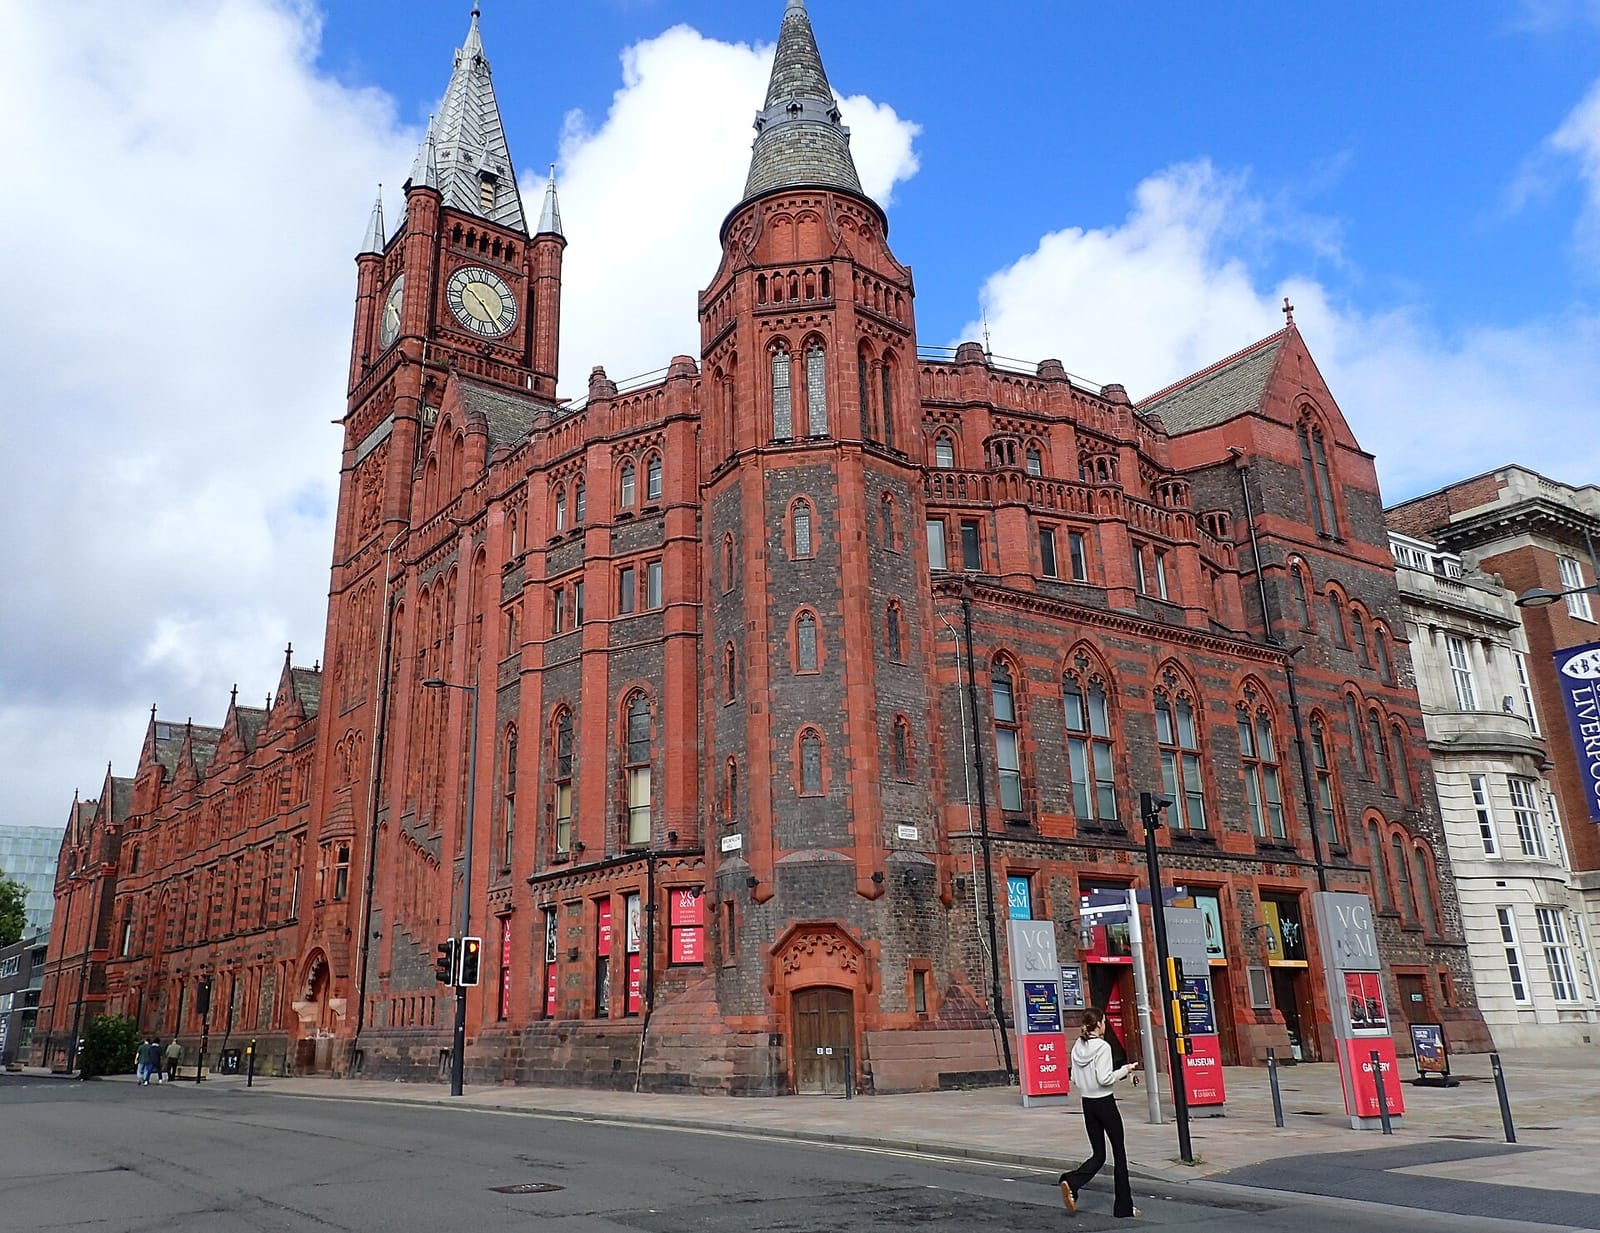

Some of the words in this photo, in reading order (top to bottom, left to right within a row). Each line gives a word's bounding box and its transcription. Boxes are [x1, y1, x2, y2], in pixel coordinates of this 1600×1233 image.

[1571, 686, 1600, 809] LIVERPO
[1007, 882, 1026, 896] VG
[680, 899, 695, 907] &M
[1008, 895, 1027, 908] &M
[1336, 905, 1367, 930] VG
[1022, 929, 1050, 949] VG
[1025, 951, 1054, 972] &M
[1045, 1054, 1050, 1062] &
[1187, 1057, 1215, 1067] MUSEUM
[1039, 1064, 1057, 1073] SHOP
[1362, 1062, 1390, 1072] GAERY
